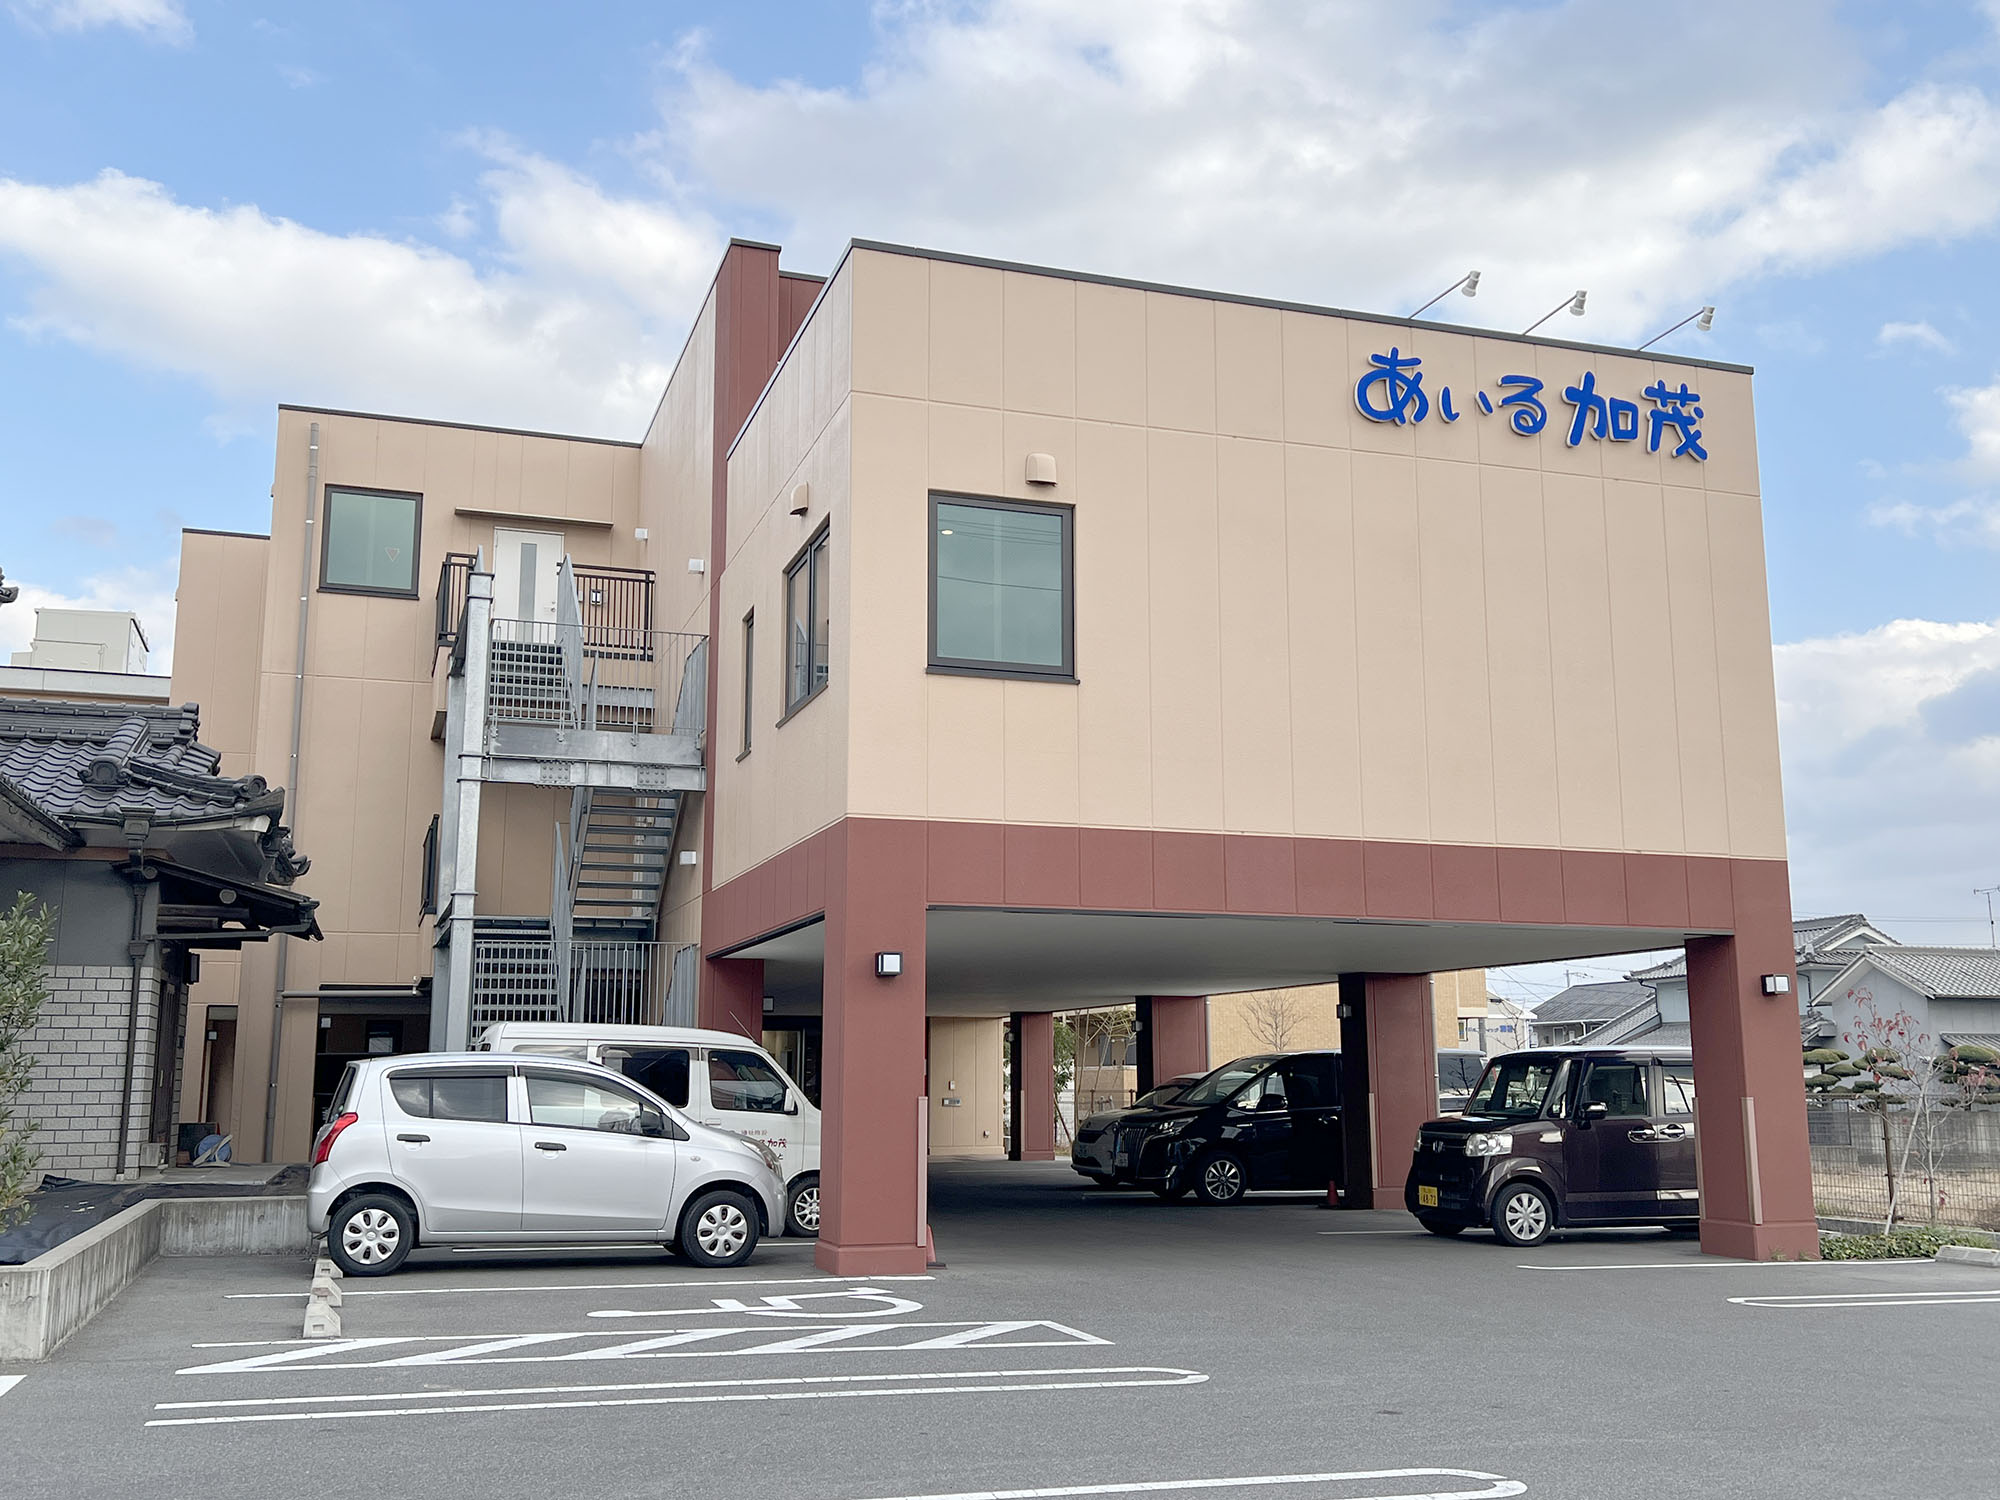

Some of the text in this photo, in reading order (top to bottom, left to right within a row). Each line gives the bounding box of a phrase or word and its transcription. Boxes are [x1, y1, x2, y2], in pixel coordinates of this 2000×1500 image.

[1355, 347, 1708, 461] あいる加茂
